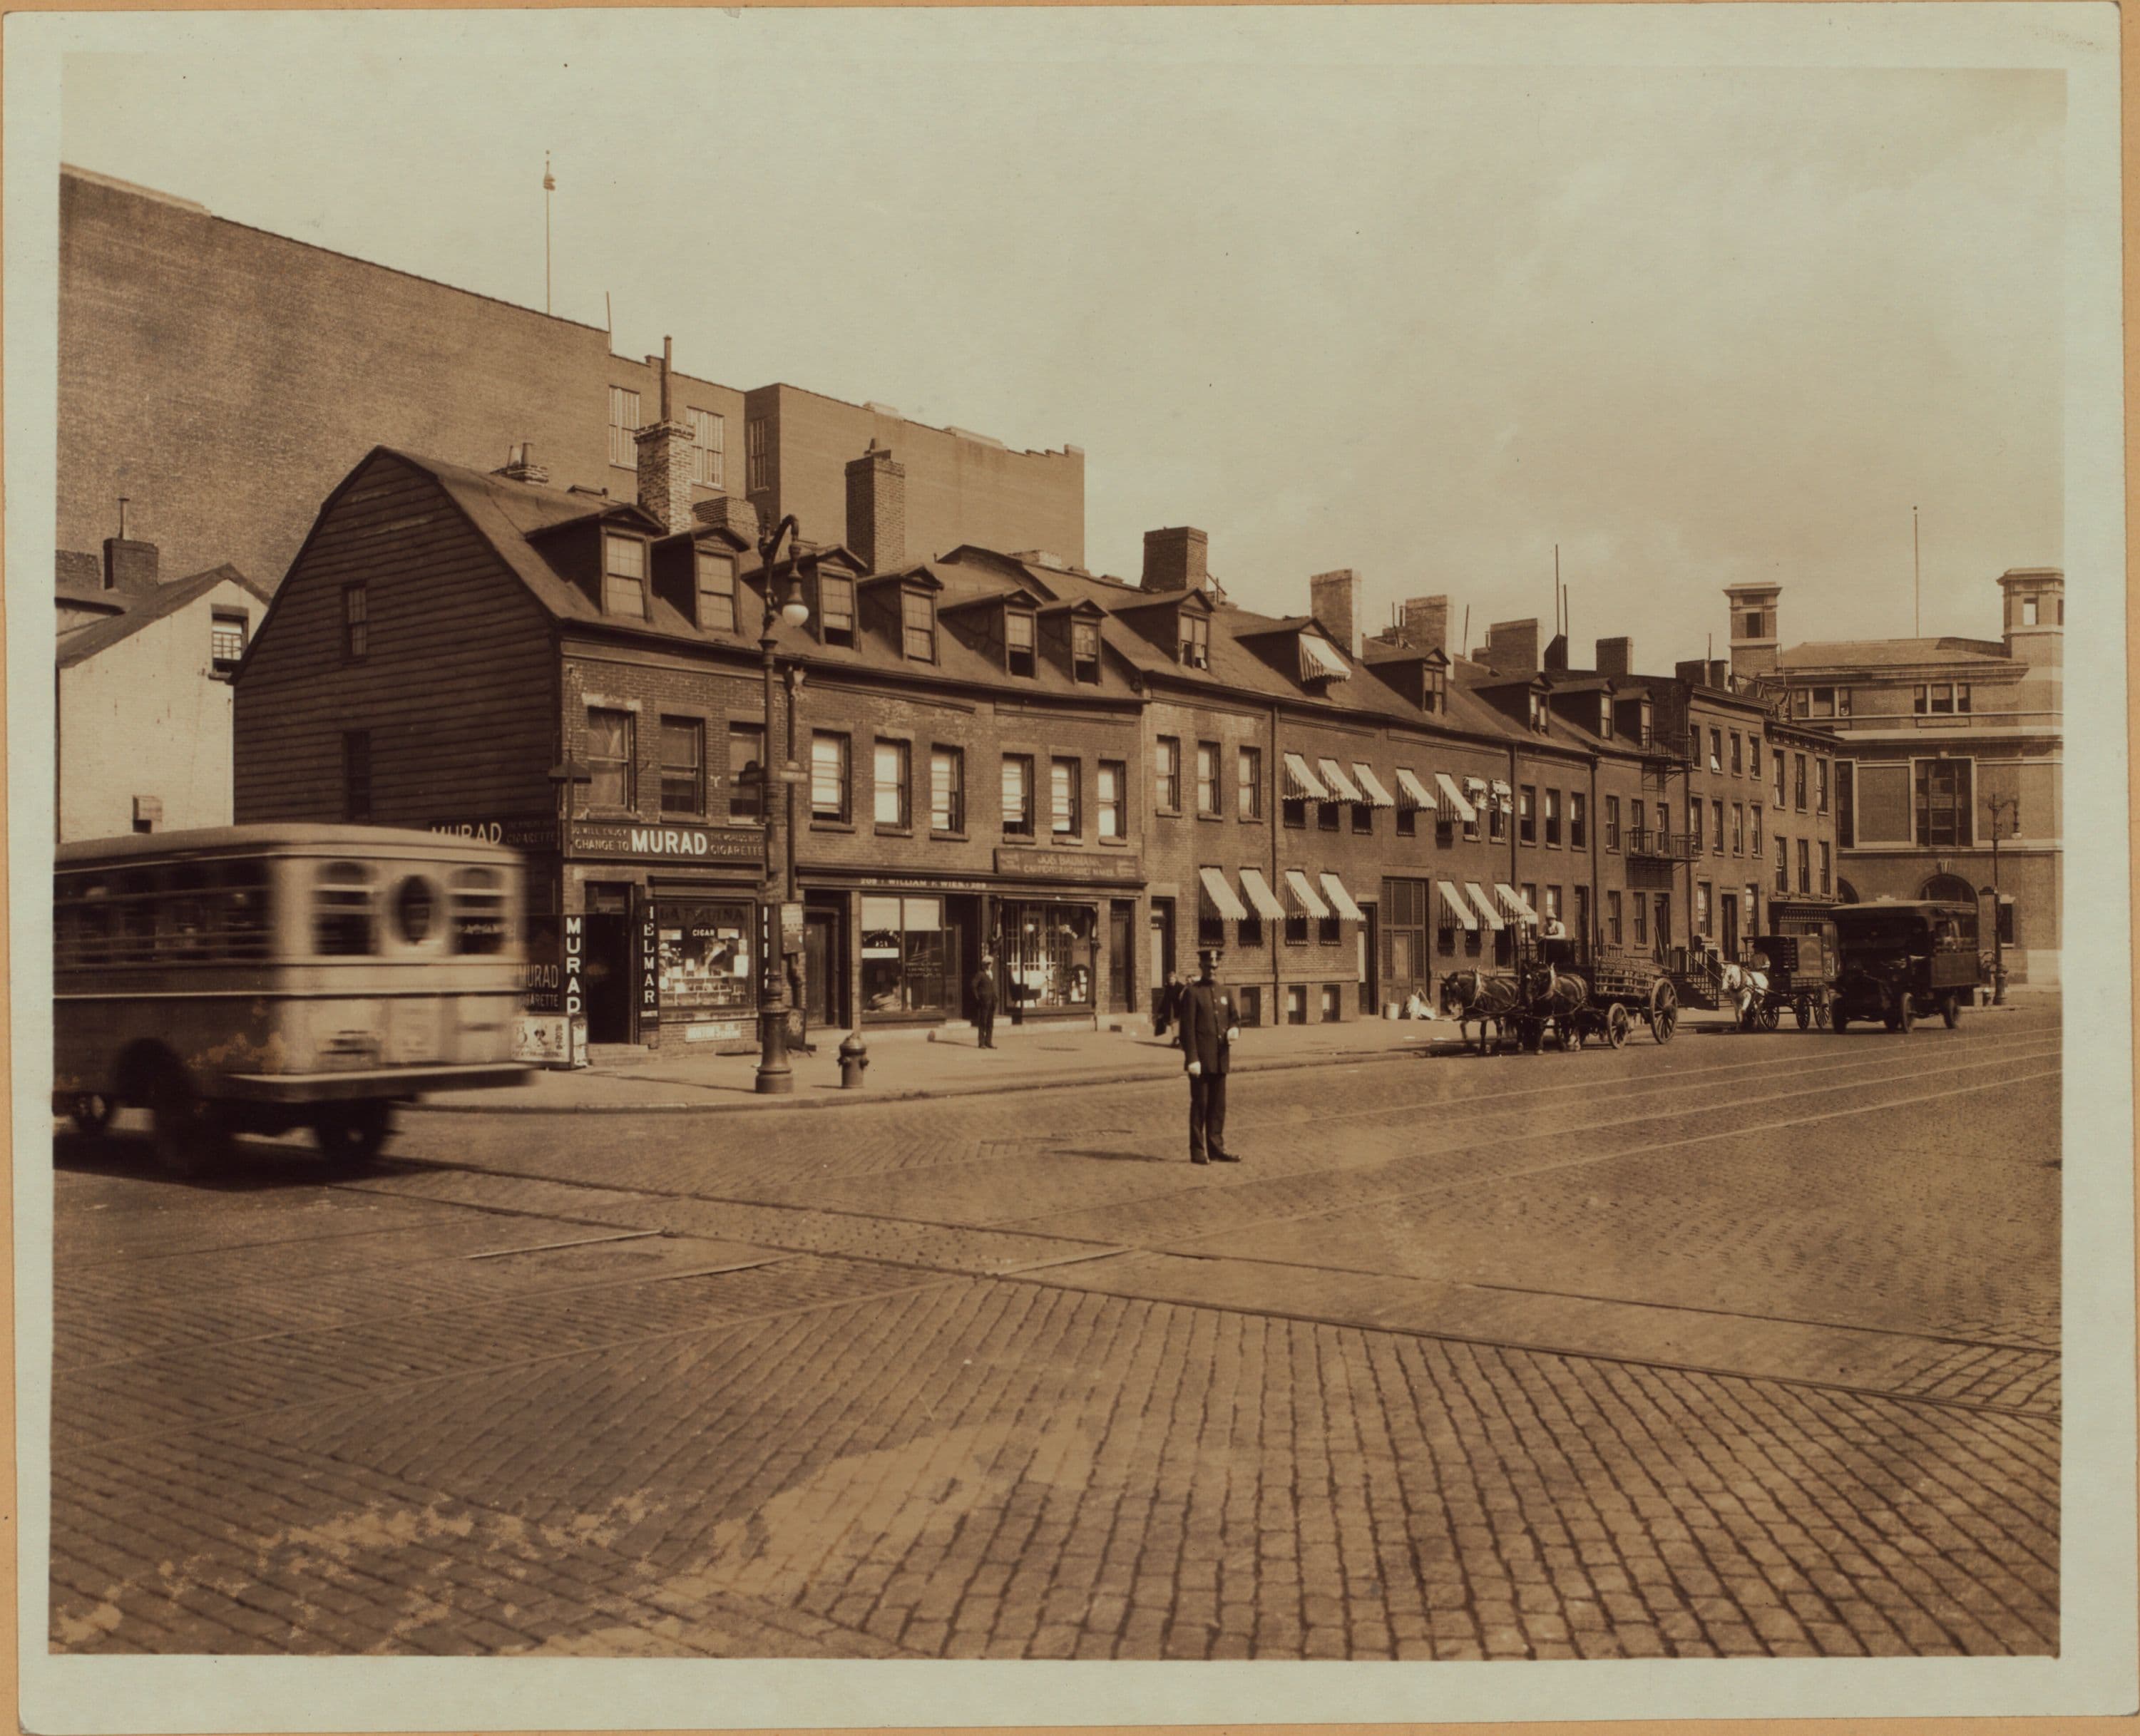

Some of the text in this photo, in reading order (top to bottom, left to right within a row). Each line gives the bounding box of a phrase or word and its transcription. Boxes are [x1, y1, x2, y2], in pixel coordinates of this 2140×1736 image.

[575, 838, 629, 851] CHANGE TO
[631, 829, 707, 856] MURAD
[710, 844, 765, 856] CIGARETTE
[692, 928, 715, 937] CIGAR
[566, 917, 581, 1014] MURAD
[518, 964, 559, 988] MURAD
[521, 993, 559, 1007] GARETTE
